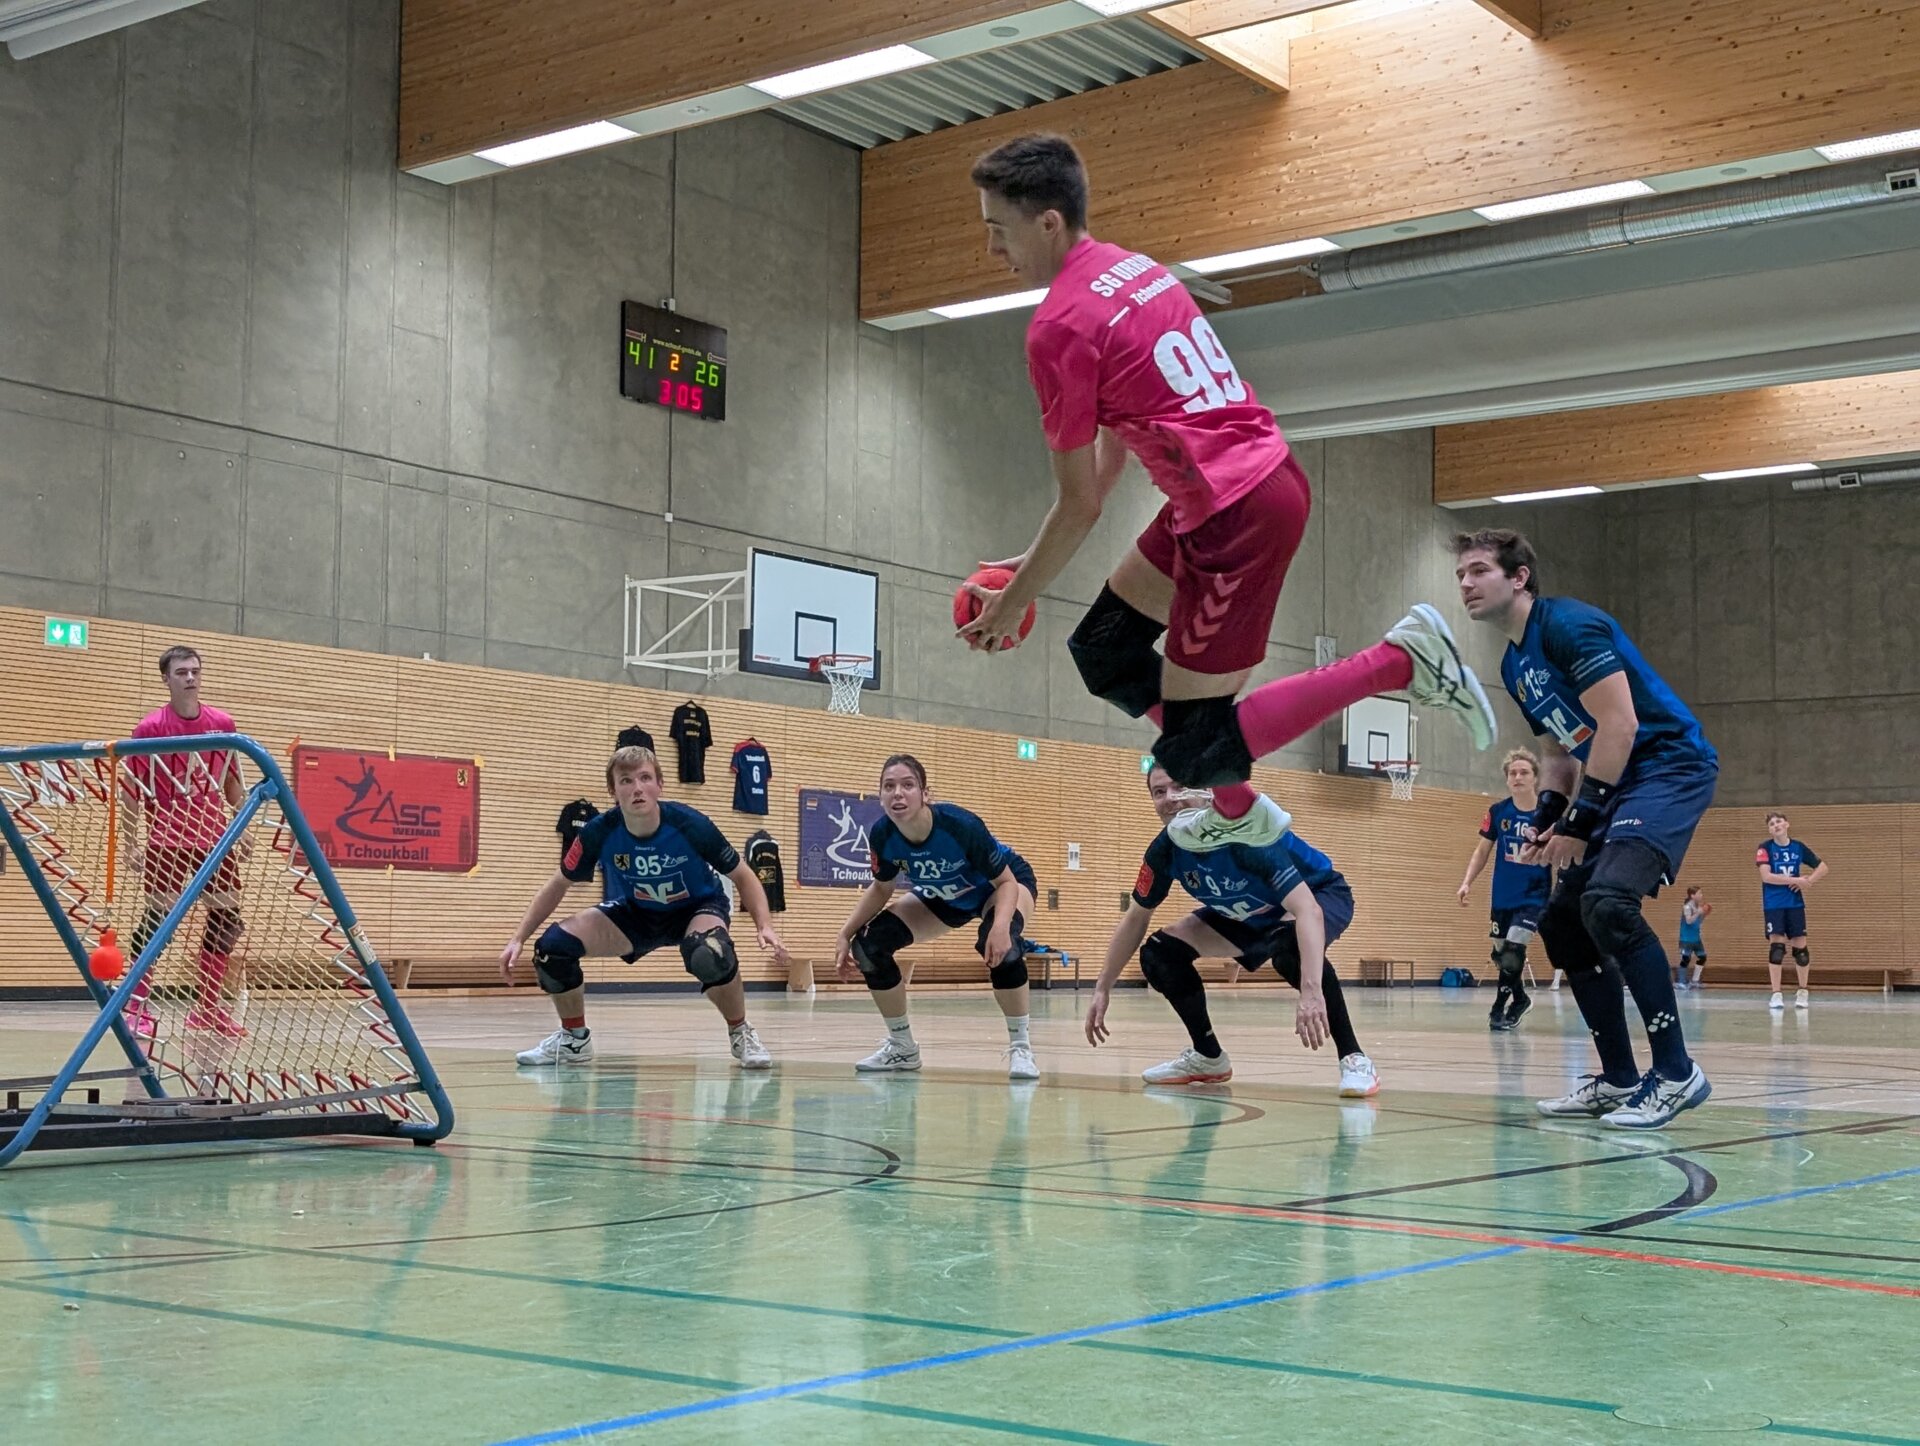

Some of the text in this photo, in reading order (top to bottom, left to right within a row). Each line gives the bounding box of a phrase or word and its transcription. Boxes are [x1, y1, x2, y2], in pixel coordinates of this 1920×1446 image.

[1090, 273, 1125, 298] SG
[629, 341, 654, 369] 41
[670, 353, 680, 371] 2
[1153, 315, 1247, 414] 99
[695, 361, 719, 387] 26
[1525, 668, 1543, 700] 13
[752, 765, 761, 784] 6
[370, 791, 442, 827] ASC
[1514, 821, 1530, 837] 16
[344, 843, 429, 861] Tchoukball
[1783, 852, 1790, 862] 3
[635, 855, 662, 876] 95
[913, 860, 941, 879] 23
[1205, 875, 1222, 897] 9
[1767, 922, 1773, 933] 3
